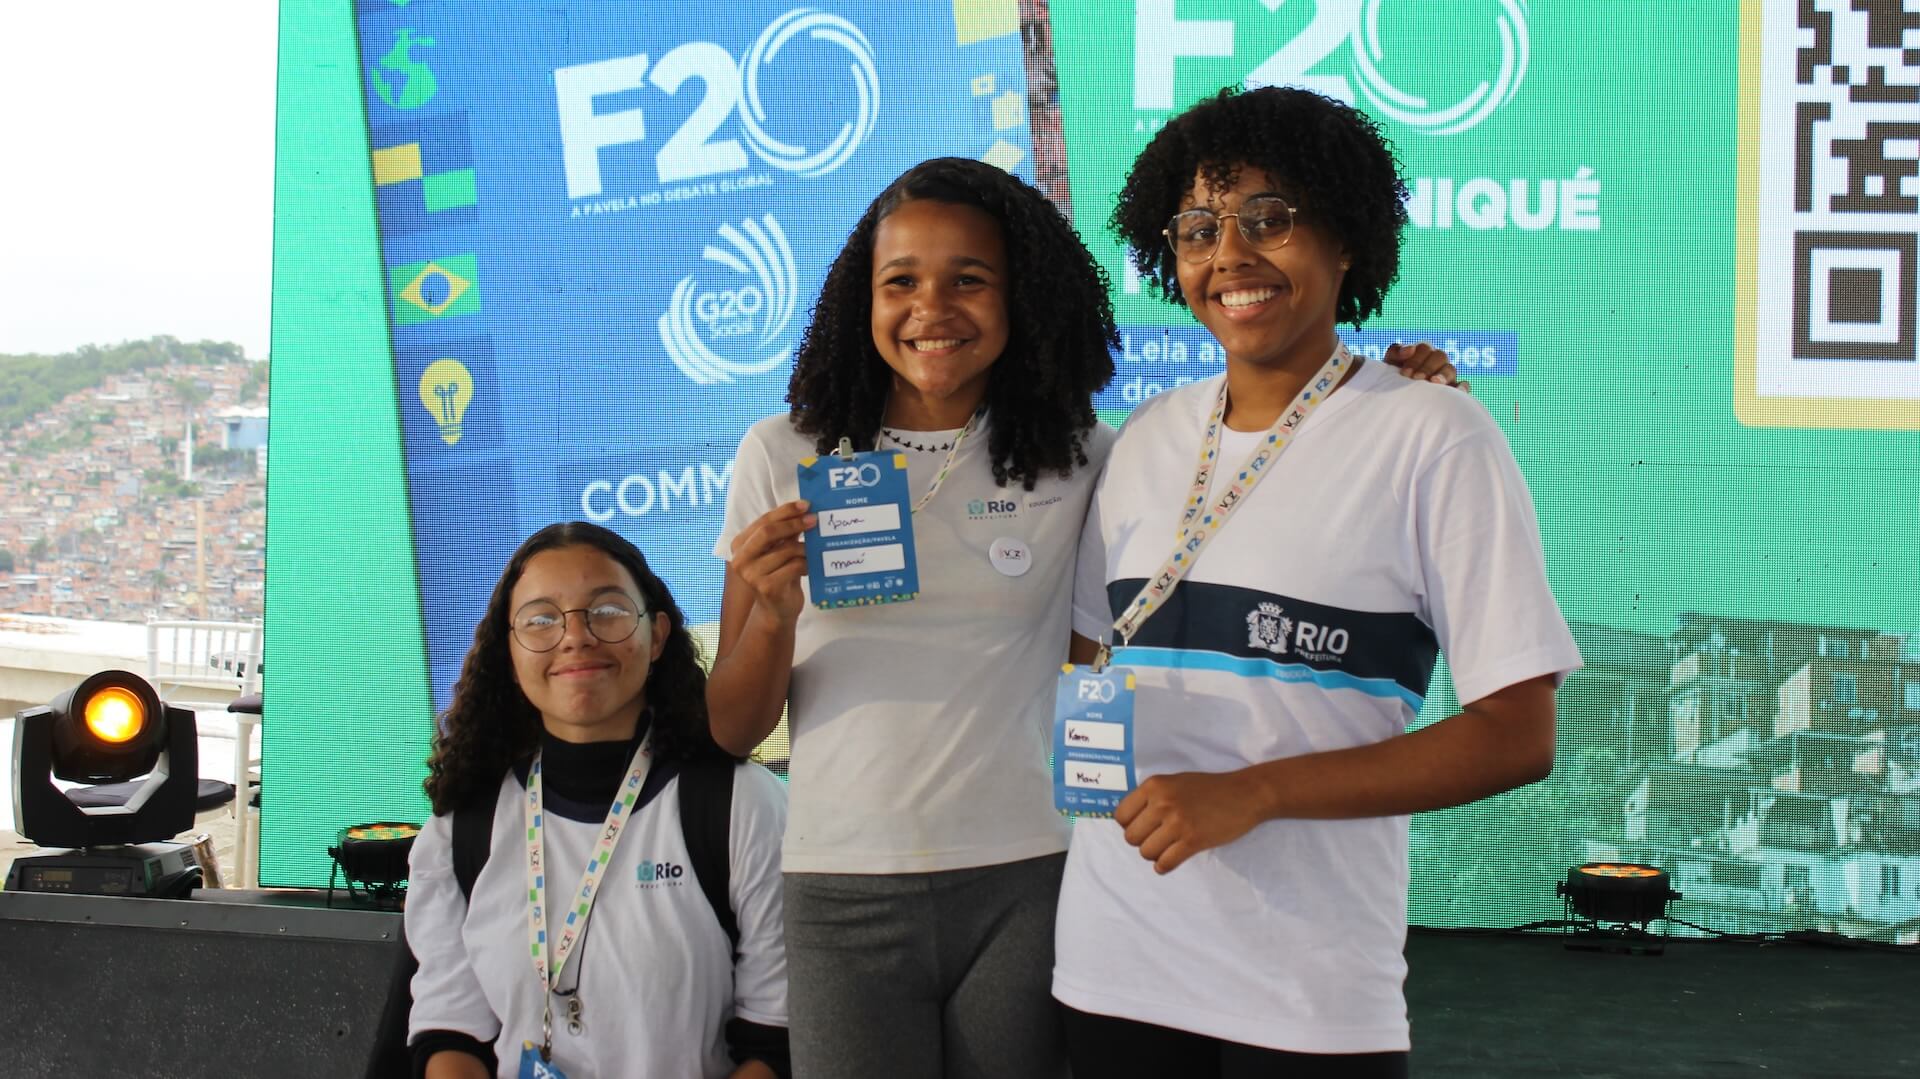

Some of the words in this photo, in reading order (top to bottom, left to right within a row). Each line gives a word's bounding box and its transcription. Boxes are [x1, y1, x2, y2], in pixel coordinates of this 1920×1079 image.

[1133, 0, 1530, 135] F20
[554, 7, 880, 200] F20
[571, 206, 581, 218] A
[584, 197, 638, 216] FAVELA
[640, 192, 662, 206] NO
[664, 183, 716, 202] DEBATE
[719, 173, 775, 192] GLOBAL
[1403, 165, 1601, 230] NIQUÉ
[695, 286, 762, 322] G20
[711, 316, 753, 338] Social
[1123, 333, 1188, 363] Leia
[1123, 376, 1163, 402] do
[828, 463, 881, 489] F20
[581, 460, 735, 521] COMM
[845, 496, 868, 506] NOME
[988, 500, 1017, 513] Rio
[1295, 621, 1350, 655] RIO
[1294, 646, 1343, 664] PREFEITURA
[1077, 679, 1116, 704] F20
[655, 862, 683, 880] Rio
